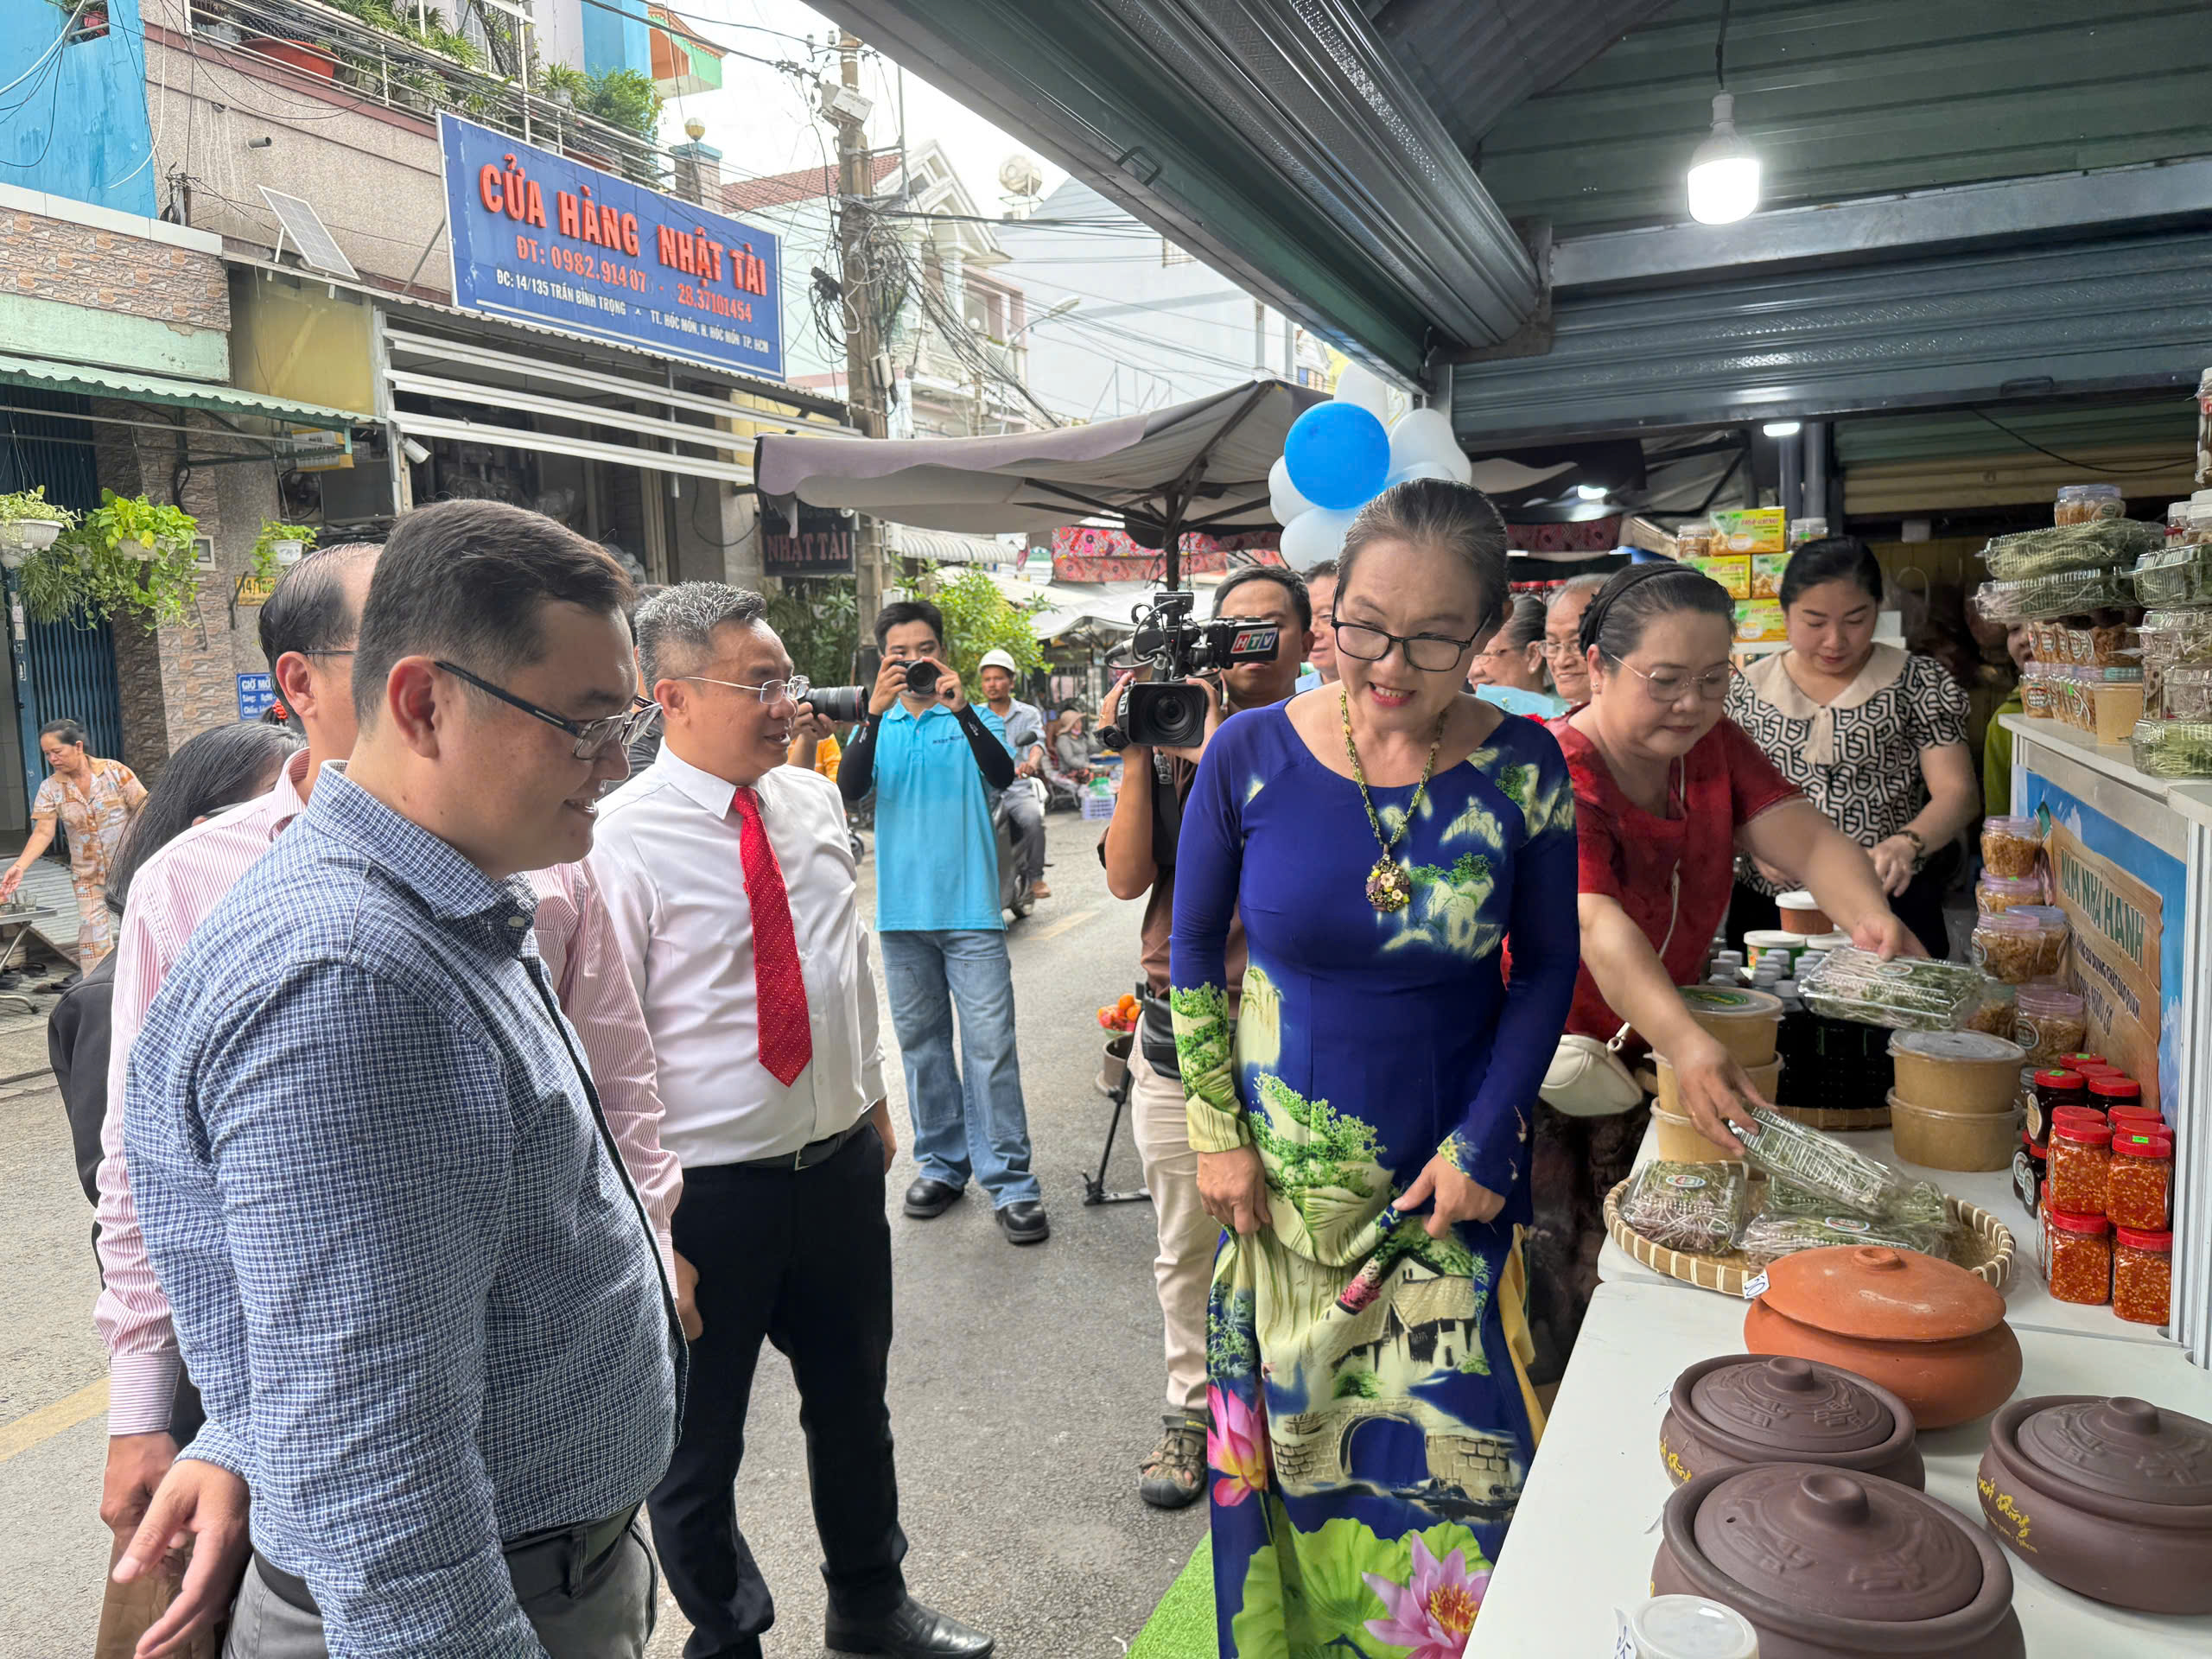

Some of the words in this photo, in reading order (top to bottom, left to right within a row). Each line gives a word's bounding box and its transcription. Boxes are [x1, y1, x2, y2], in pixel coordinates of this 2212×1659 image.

[480, 153, 547, 229] CỬA
[557, 184, 641, 257] HÀNG
[657, 224, 724, 288] NHẬT
[728, 242, 767, 296] TÀI
[517, 234, 545, 265] ĐT:
[496, 269, 514, 288] ĐC:
[516, 274, 549, 296] 14/135
[575, 287, 596, 308] BÌNH
[597, 296, 626, 316] TRỌNG
[817, 523, 849, 560] TÀI
[1234, 632, 1274, 650] HTV
